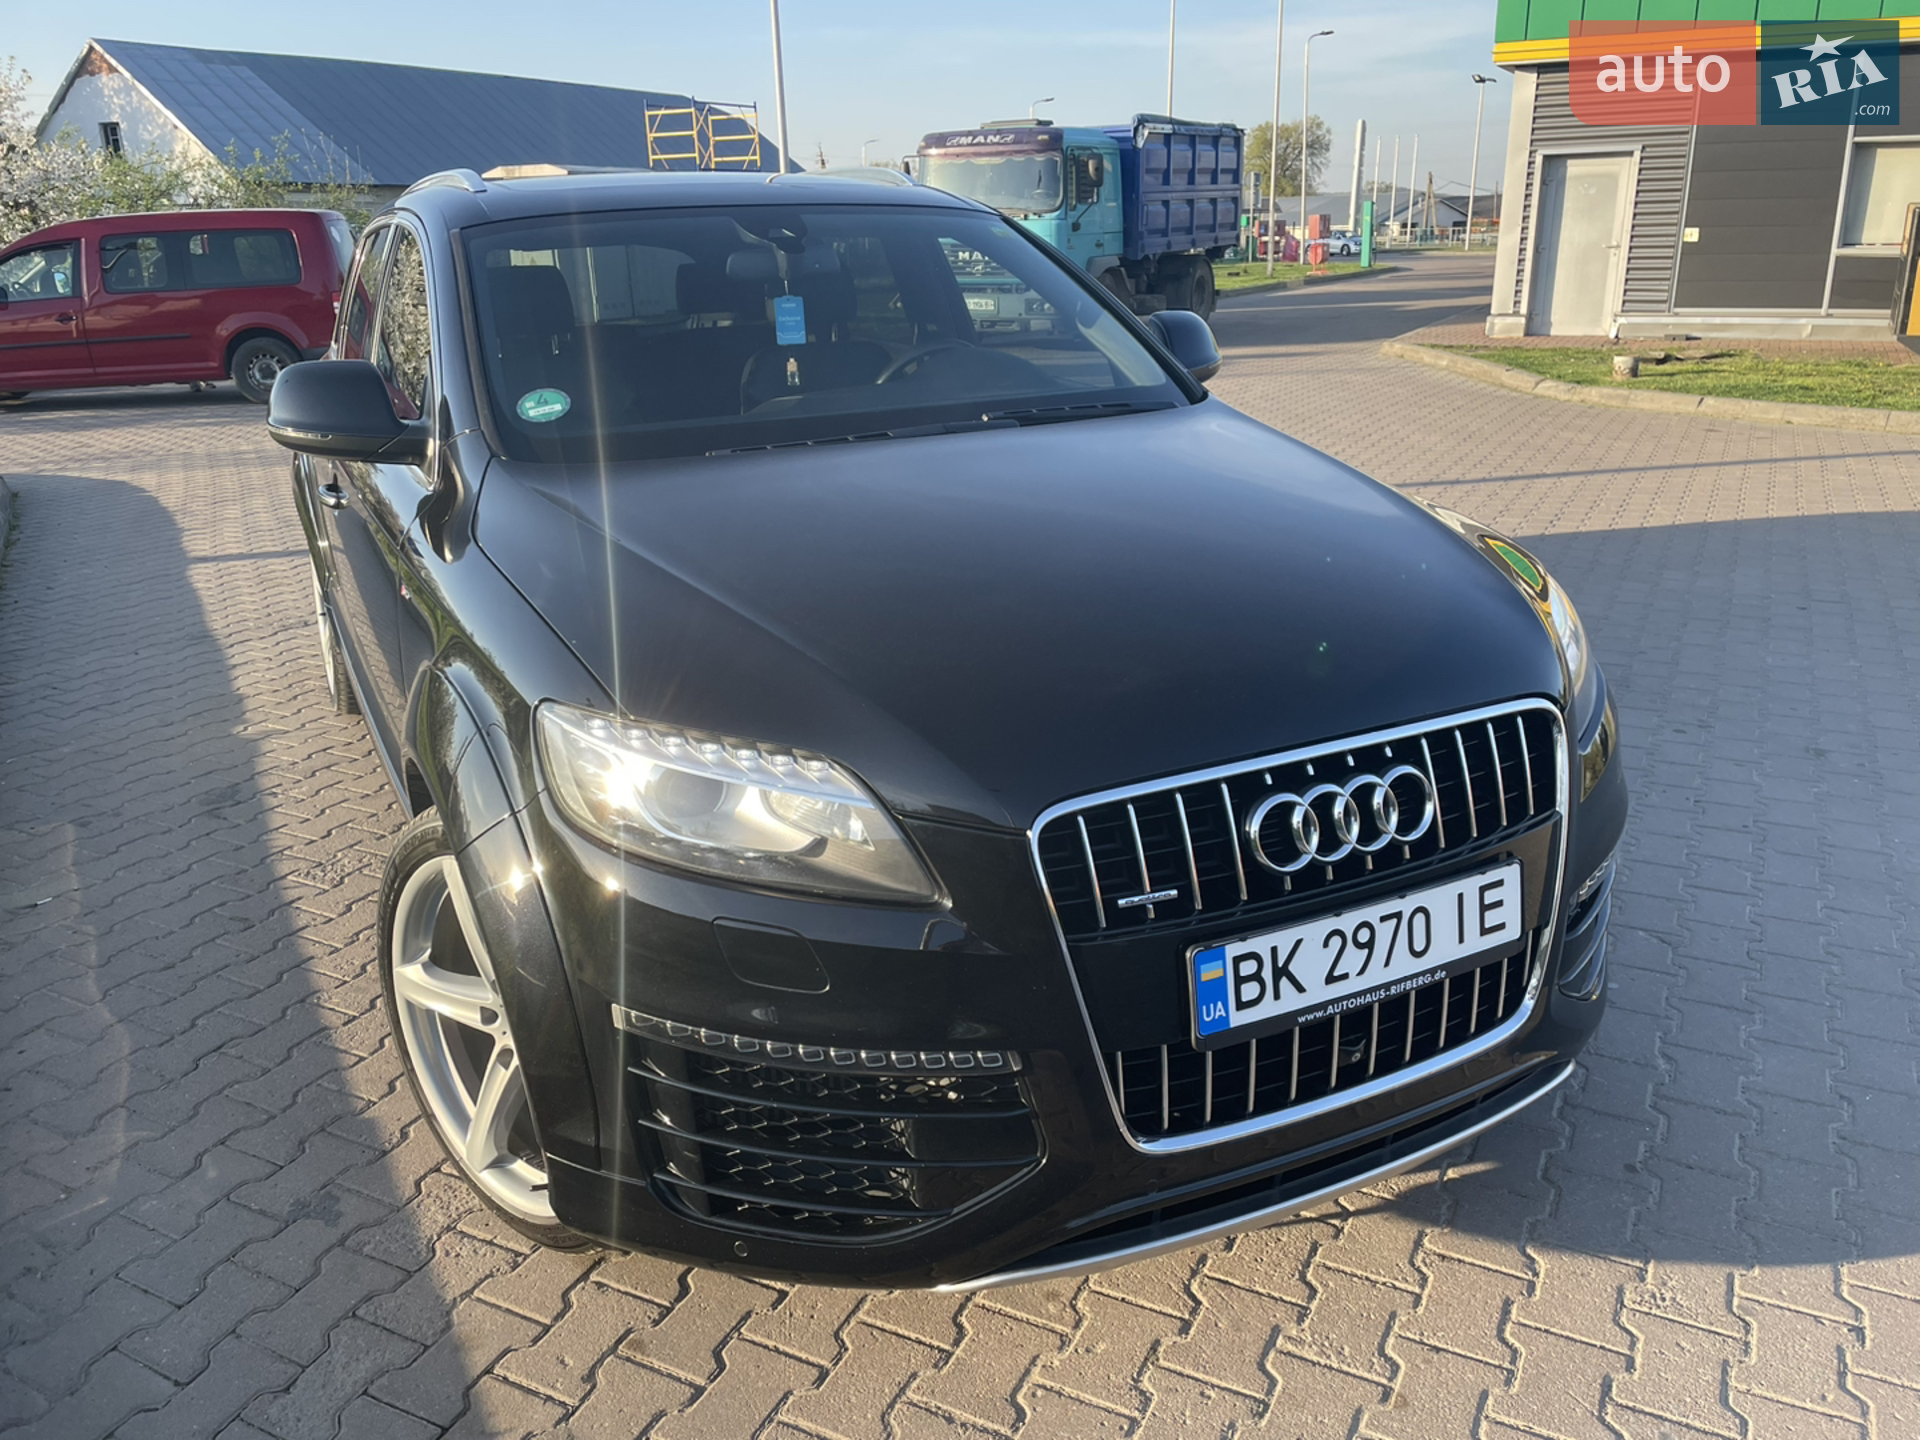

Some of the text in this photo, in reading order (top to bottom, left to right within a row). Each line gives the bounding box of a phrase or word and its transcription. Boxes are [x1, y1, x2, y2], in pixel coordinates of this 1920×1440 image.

[958, 134, 1000, 146] MAN
[958, 251, 989, 260] MA
[537, 393, 549, 405] 4
[1232, 878, 1506, 1012] BK 2970 IE
[1297, 970, 1447, 1023] www.AUTOHAUS-RIFBERG.de
[1202, 1001, 1227, 1022] UA
